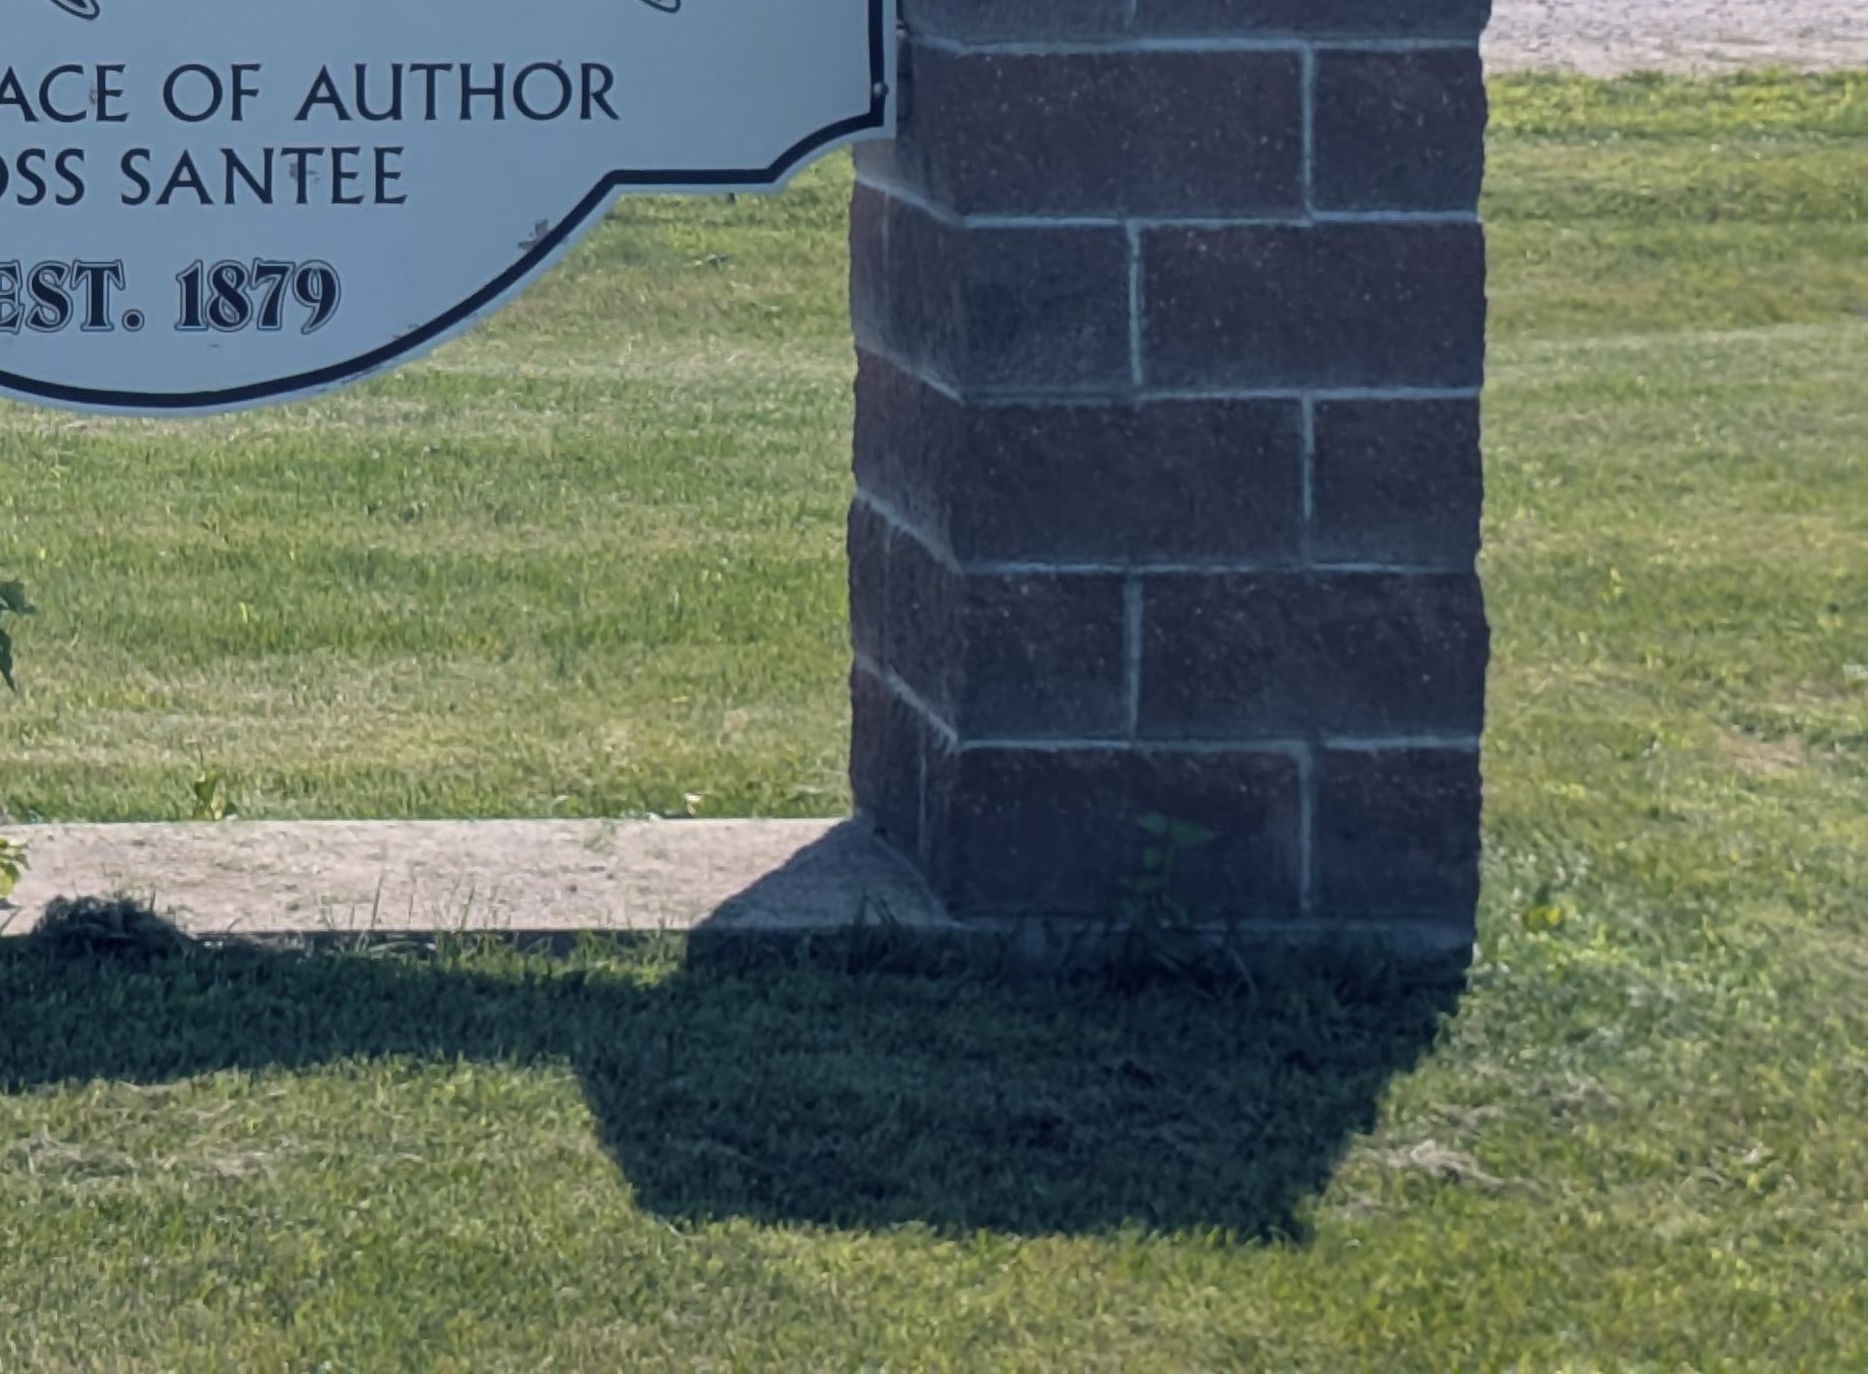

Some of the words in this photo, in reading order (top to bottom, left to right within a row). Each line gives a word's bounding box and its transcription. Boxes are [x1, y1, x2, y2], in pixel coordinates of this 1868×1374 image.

[163, 63, 262, 122] OF
[294, 61, 620, 120] AUTHOR
[120, 146, 408, 205] SANTEE
[175, 258, 341, 334] 1879
